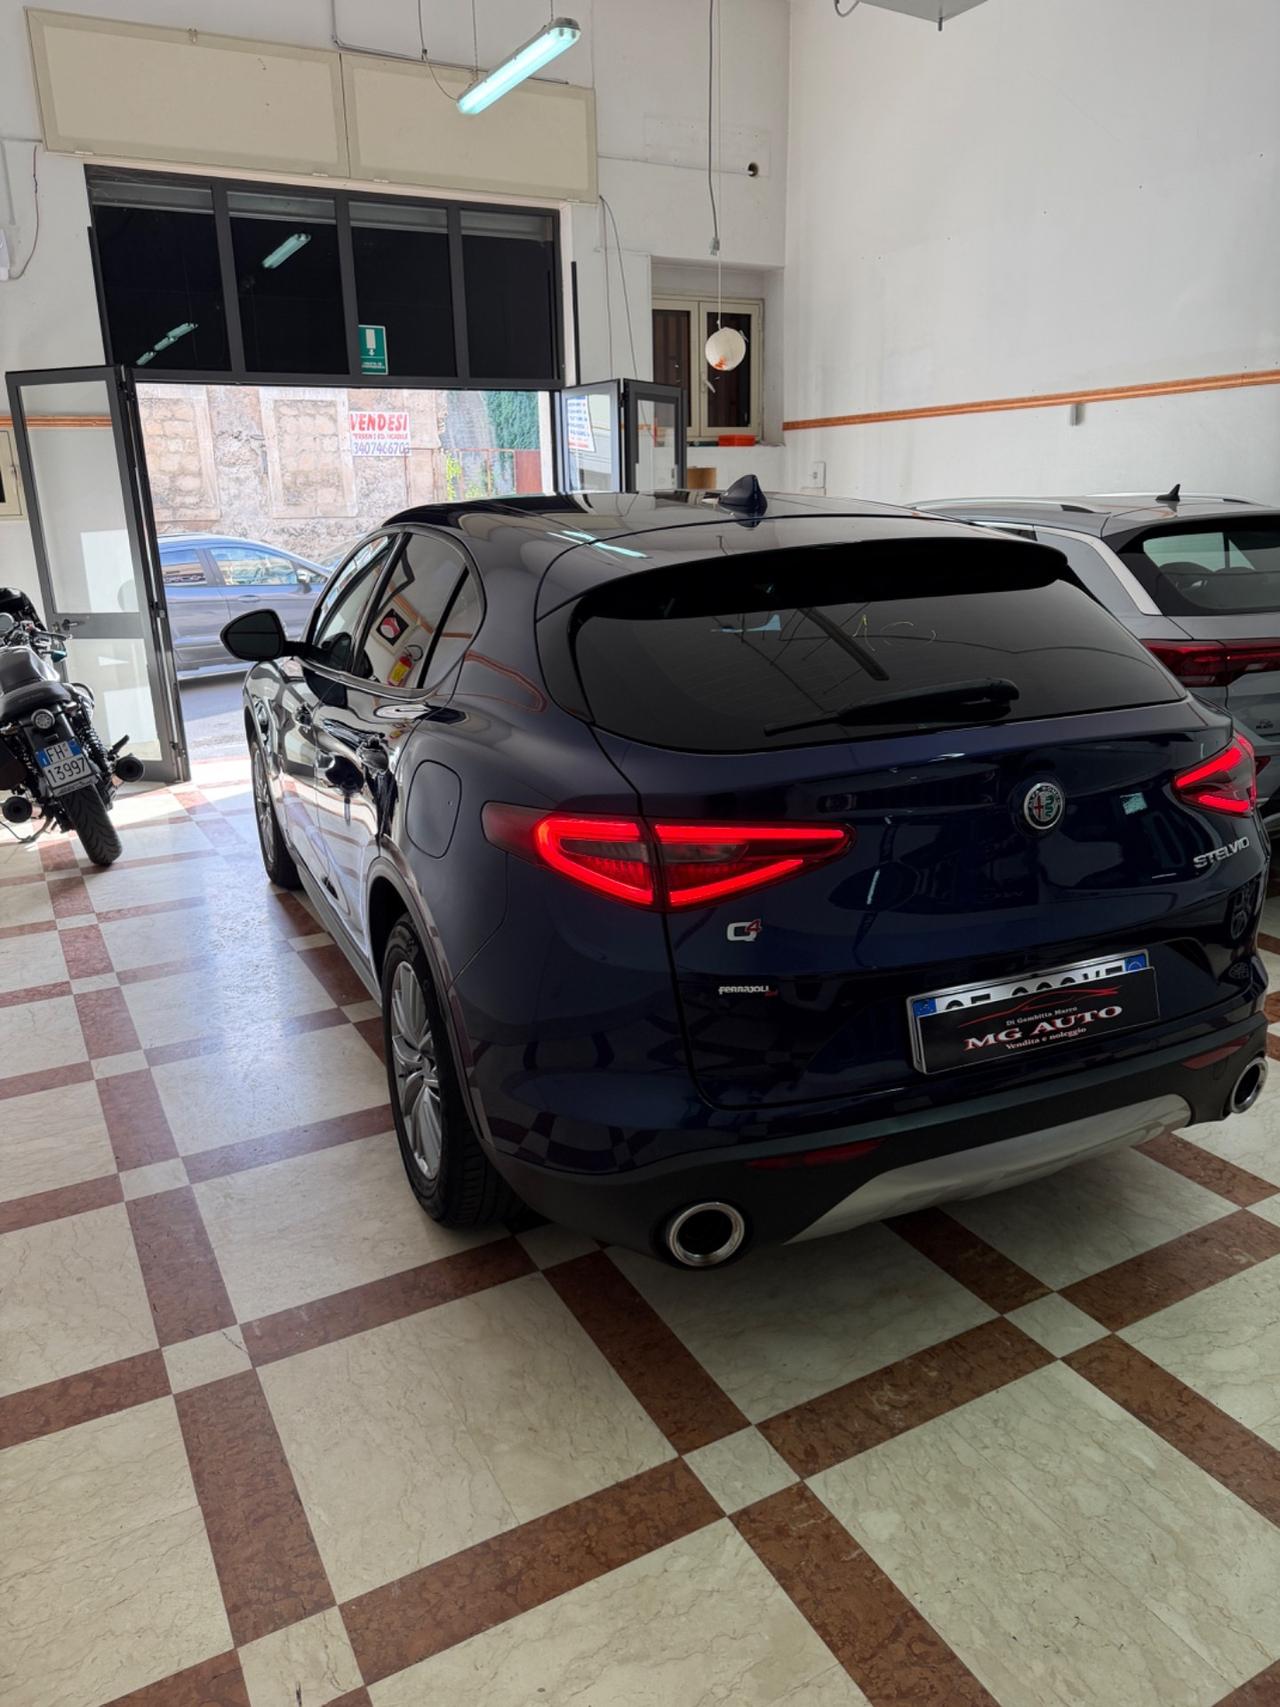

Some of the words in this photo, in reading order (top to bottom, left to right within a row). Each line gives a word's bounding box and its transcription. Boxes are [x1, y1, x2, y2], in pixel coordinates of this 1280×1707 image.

[350, 413, 407, 431] VENDESI
[46, 745, 65, 763] FH
[48, 757, 85, 783] 13997
[1193, 836, 1250, 868] STELVIO
[727, 918, 762, 942] Q4
[1031, 1005, 1122, 1035] AUTO
[1006, 1037, 1040, 1050] Vendita
[1049, 1026, 1087, 1040] noleggio
